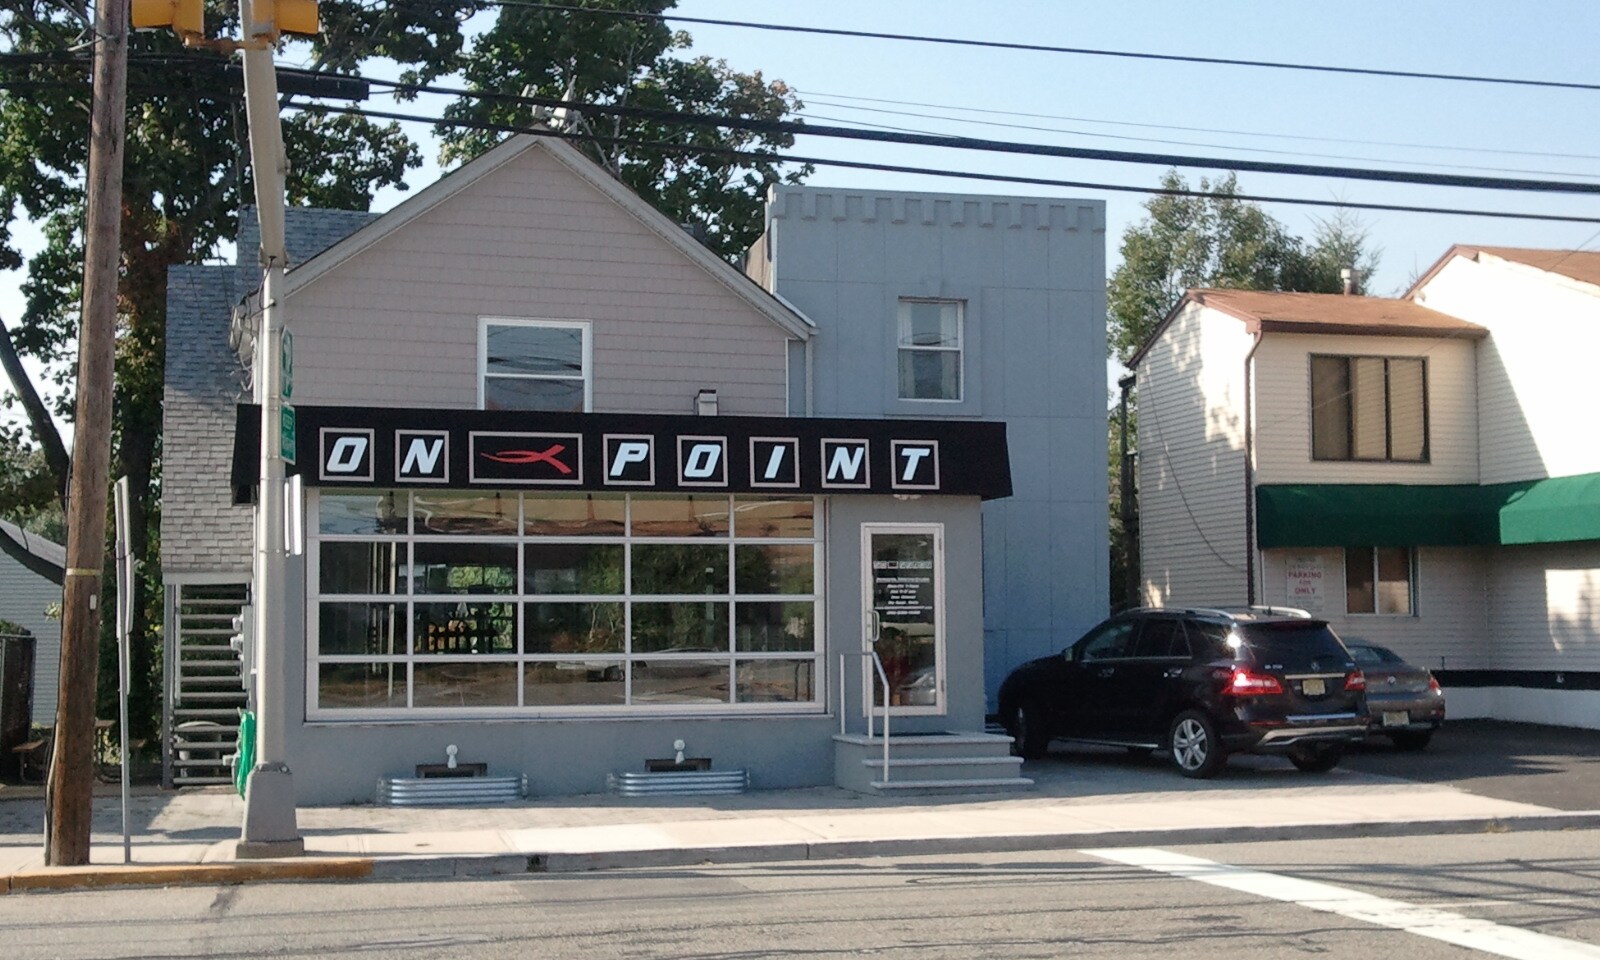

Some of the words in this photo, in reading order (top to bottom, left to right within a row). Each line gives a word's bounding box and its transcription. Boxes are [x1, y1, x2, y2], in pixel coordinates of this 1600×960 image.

[326, 436, 444, 474] ON
[609, 442, 930, 481] POINT
[1288, 570, 1322, 578] PARKING
[1294, 587, 1316, 595] ONLY
